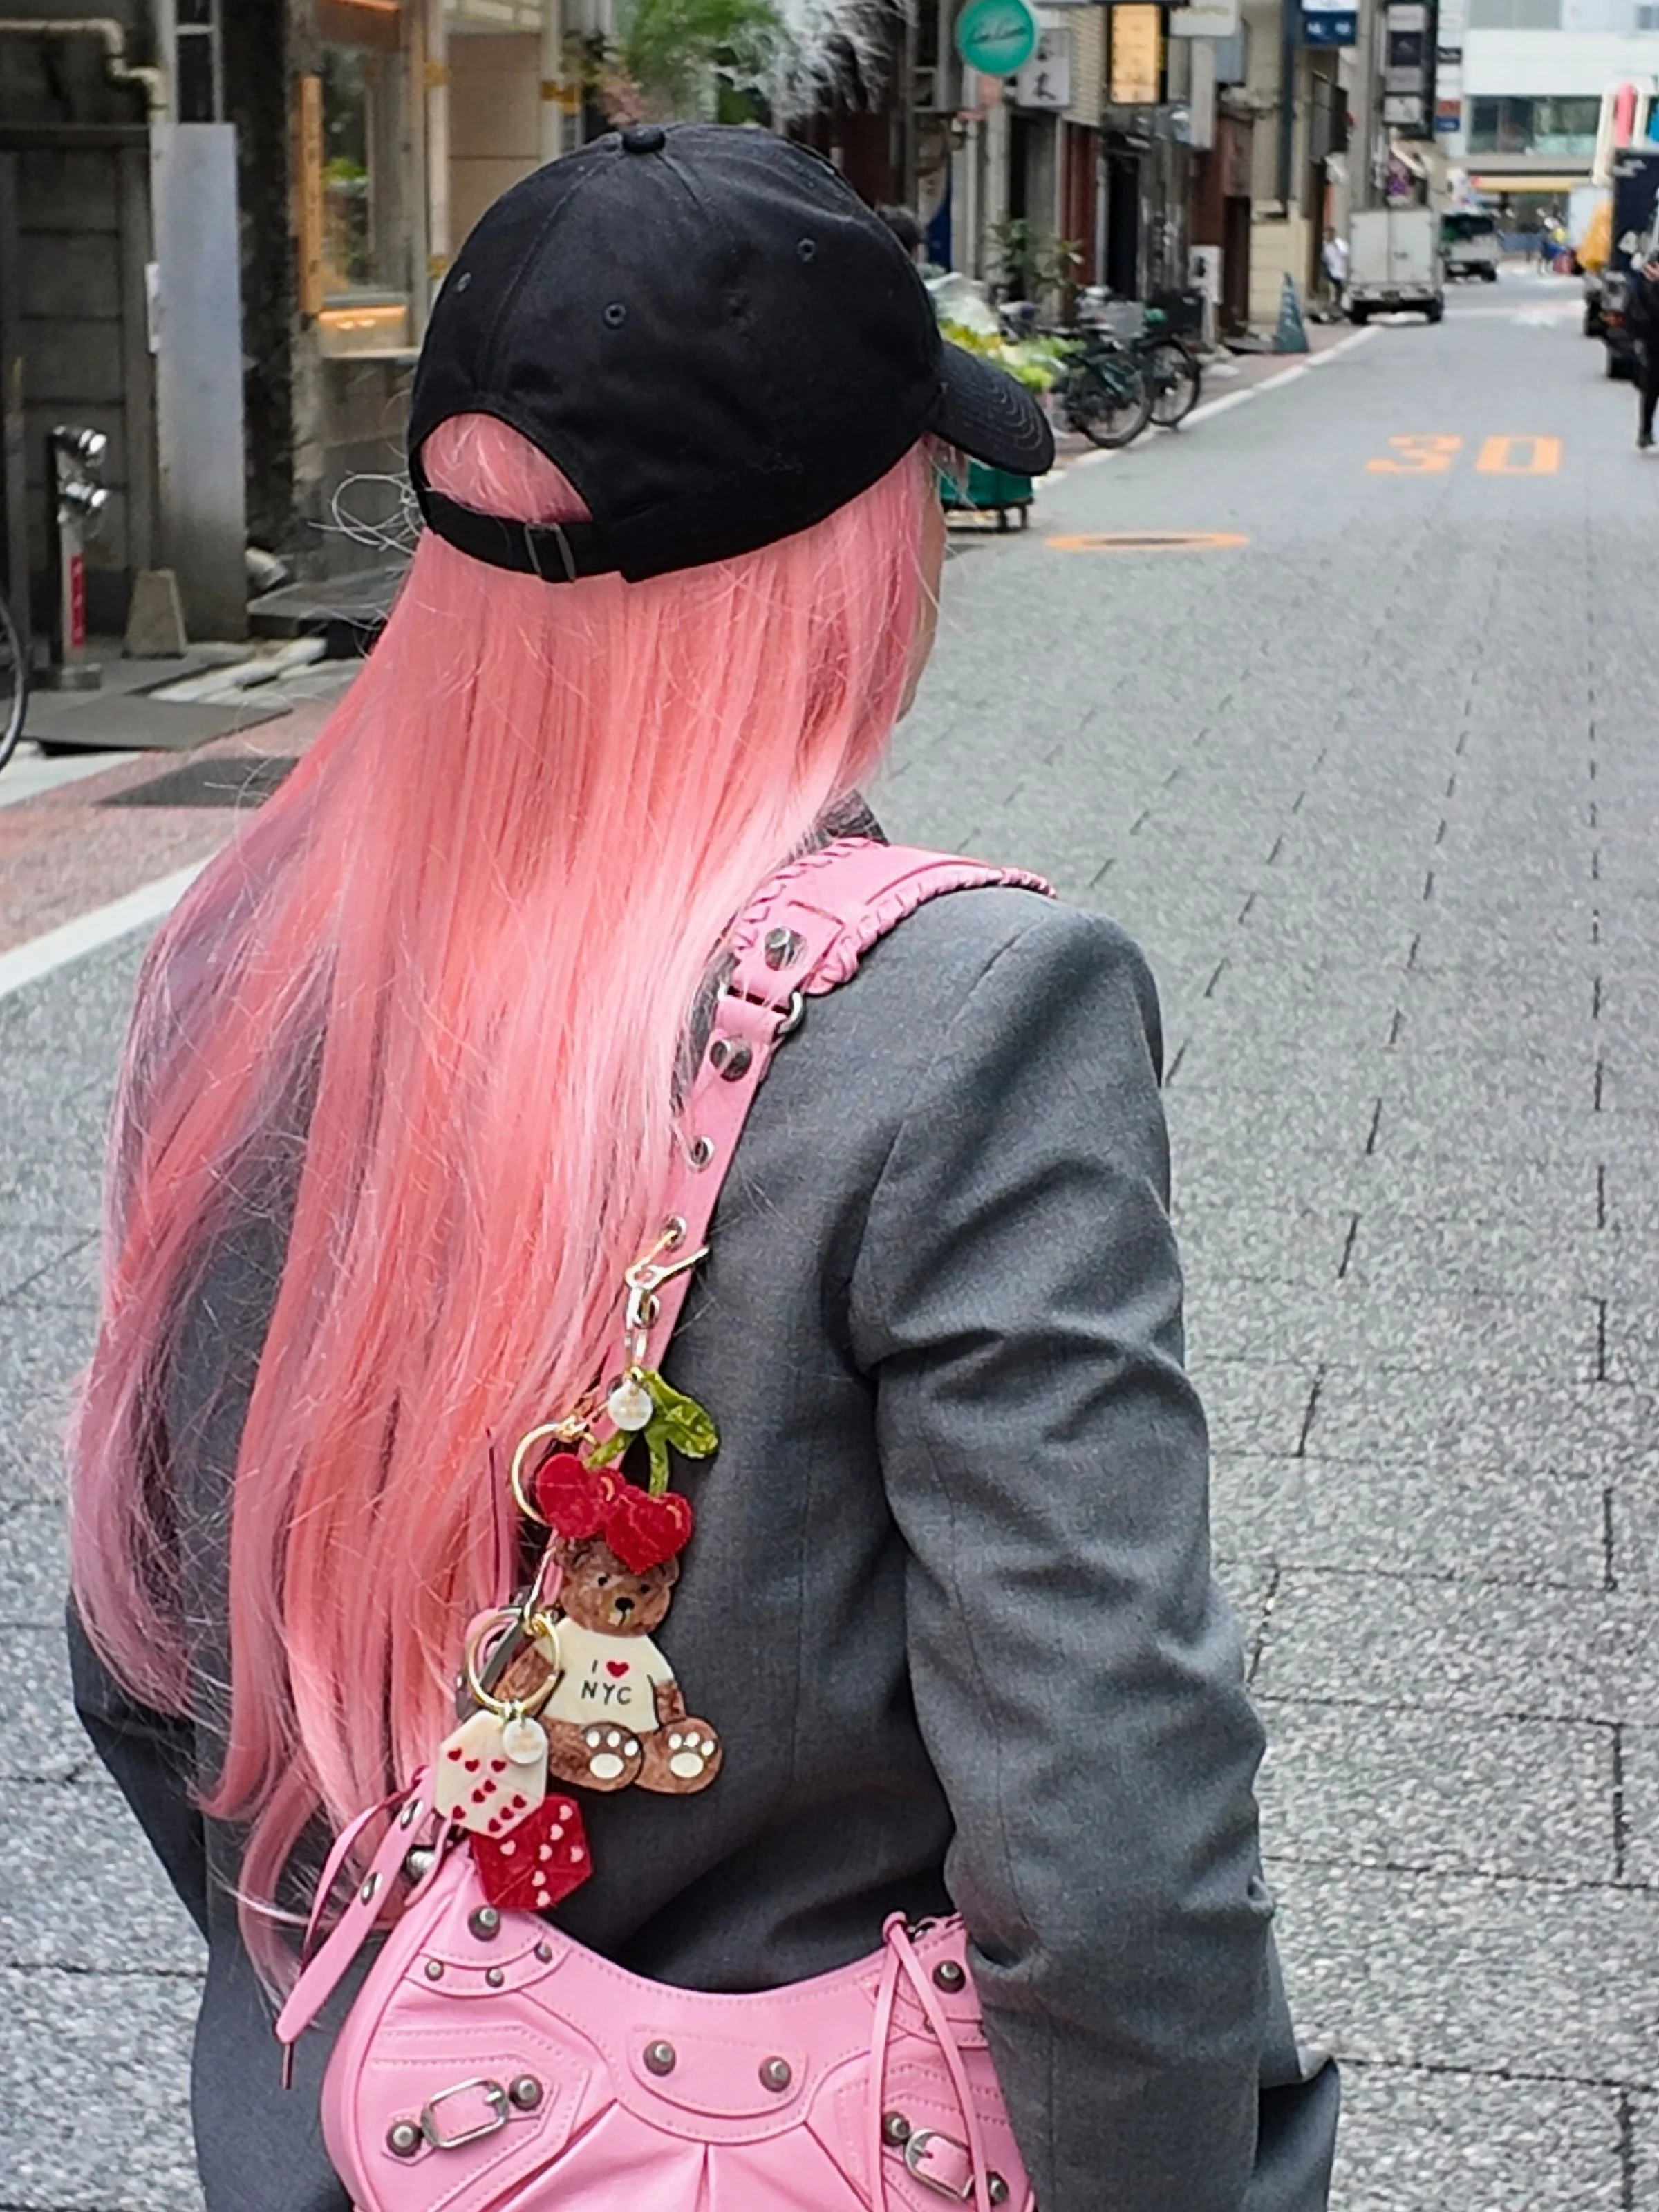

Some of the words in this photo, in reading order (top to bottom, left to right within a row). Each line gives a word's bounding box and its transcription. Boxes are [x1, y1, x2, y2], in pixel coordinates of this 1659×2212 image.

[1365, 433, 1562, 473] 30
[592, 1659, 598, 1674] I
[581, 1680, 632, 1706] NYC
